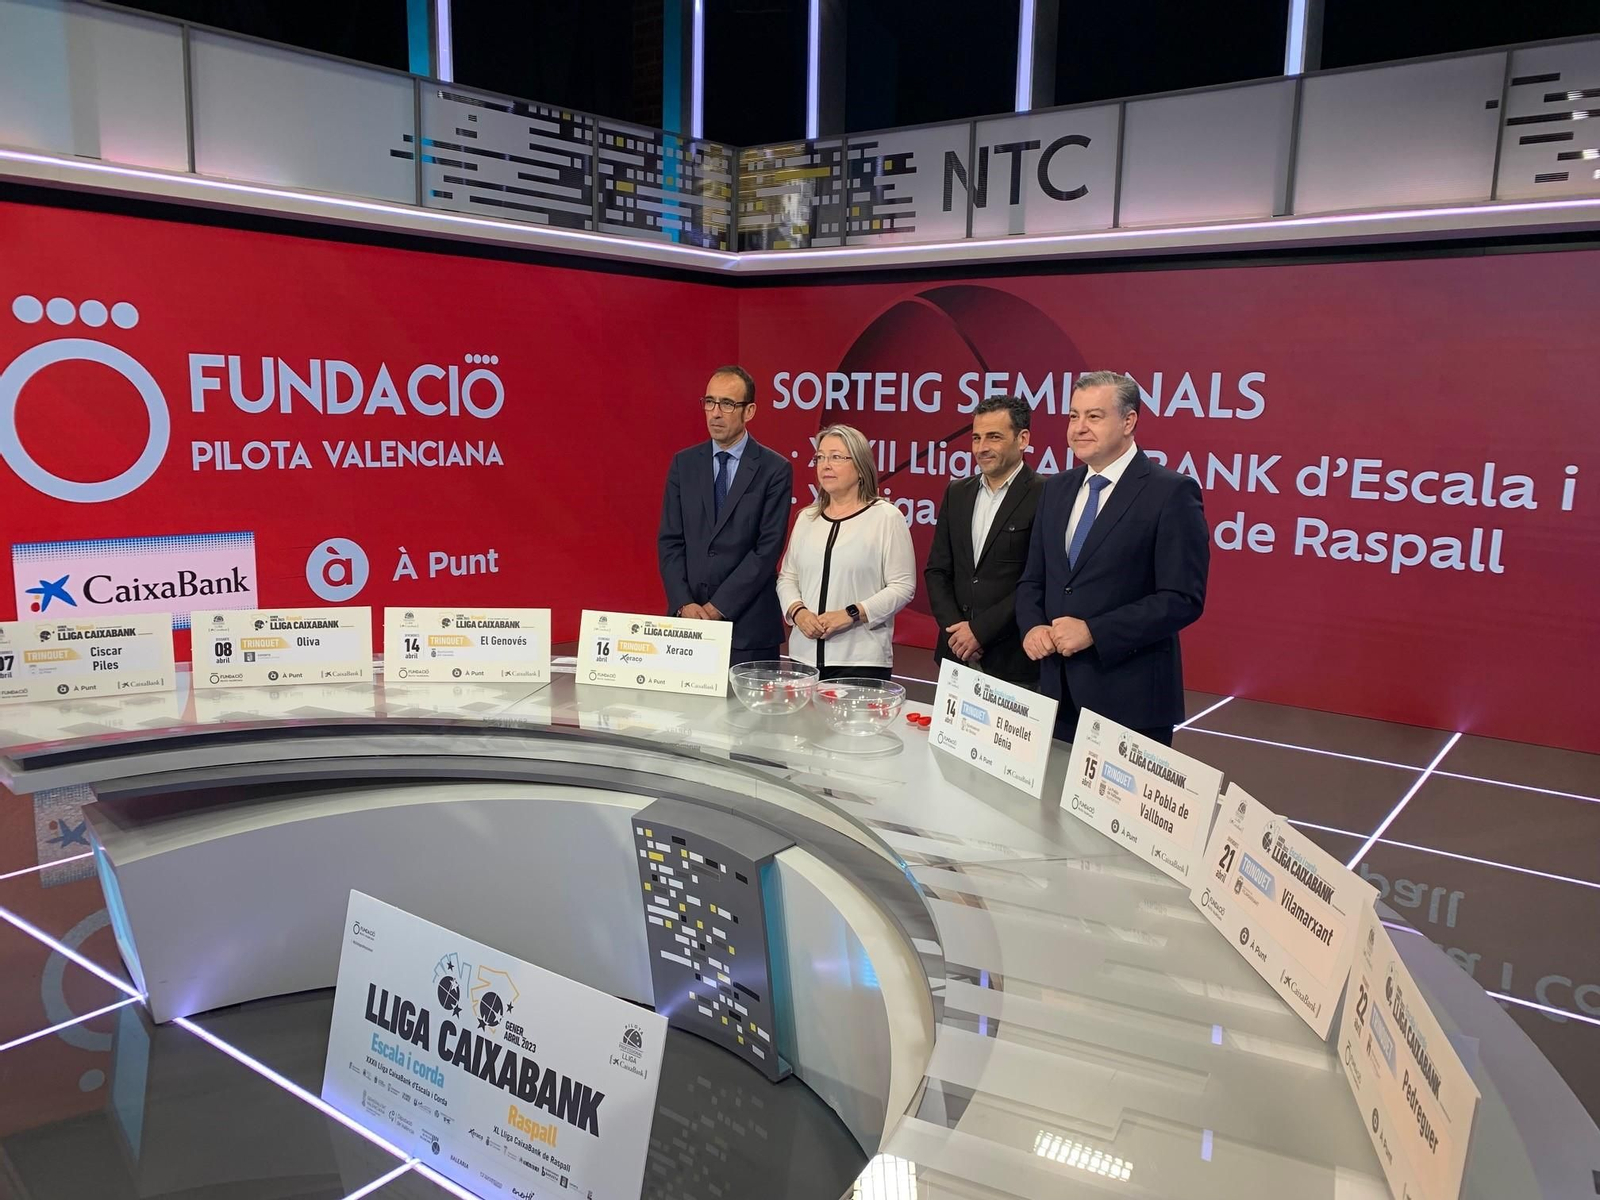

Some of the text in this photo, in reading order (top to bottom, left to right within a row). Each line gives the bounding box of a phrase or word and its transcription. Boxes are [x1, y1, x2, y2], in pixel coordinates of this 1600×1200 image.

[943, 135, 1091, 211] NTC
[773, 371, 1266, 419] SORTEIG SEMINALS
[192, 440, 504, 470] PILOTA VALENCIANA
[910, 440, 982, 479] Llig
[1561, 465, 1579, 511] i
[1214, 512, 1276, 554] de
[1294, 517, 1505, 574] Raspall
[392, 546, 499, 582] À Punt
[82, 566, 250, 605] CaixaBank
[57, 630, 84, 641] LLIGA
[84, 628, 136, 640] CAIXABANK
[270, 620, 339, 630] LLIGA CAIXABANK
[456, 620, 520, 629] LLIGA CAIXABANK
[644, 627, 703, 640] LLIGA CAIXABANK
[90, 646, 123, 657] Ciscar
[214, 642, 233, 657] 08
[243, 639, 280, 648] TRINQUET
[296, 637, 321, 647] Oliva
[404, 638, 420, 652] 14
[430, 636, 464, 645] TRINQUET
[480, 635, 527, 646] El Genovés
[596, 641, 610, 656] 16
[666, 645, 693, 656] Xeraco
[27, 650, 69, 661] TRINQUET
[93, 660, 119, 671] Piles
[620, 654, 643, 663] Xeraco
[946, 698, 956, 718] 14
[982, 690, 997, 705] LLIGA
[997, 697, 1030, 718] CAIXABANK
[996, 717, 1031, 742] El Rovellet
[994, 732, 1012, 751] Dénia
[1084, 757, 1097, 780] 15
[1104, 764, 1132, 788] TRINQUET
[1128, 751, 1187, 789] LLIGA CAIXABANK
[1081, 778, 1092, 789] abril
[1143, 783, 1189, 820] La Pobla de
[1140, 803, 1174, 834] Vallbona
[1126, 831, 1138, 843] Punt
[1161, 852, 1186, 873] CaixaBank
[1219, 844, 1236, 873] 21
[1215, 869, 1227, 883] abril
[1241, 857, 1271, 891] TRINQUET
[1271, 845, 1291, 872] LLIGA
[1290, 860, 1335, 905] CAIXABANK
[1281, 888, 1333, 946] Vilamarxant
[1255, 946, 1267, 962] Punt
[1290, 981, 1317, 1013] CaixaBank
[1356, 984, 1368, 1026] 22
[504, 1031, 537, 1053] ABRIL 2023
[1392, 998, 1407, 1039] LLIGA
[1406, 1026, 1441, 1101] CAIXABANK
[364, 983, 606, 1138] LLIGA CAIXABANK
[371, 1032, 445, 1089] Escala i corda
[622, 1053, 637, 1064] LLIGA
[377, 1061, 388, 1074] Lliga
[388, 1068, 411, 1086] CaixaBank
[433, 1094, 448, 1107] Corda
[1402, 1069, 1439, 1155] Pedreguer
[508, 1104, 559, 1148] Raspall
[493, 1125, 500, 1135] XL
[500, 1129, 513, 1142] Lliga
[514, 1137, 541, 1157] CaixaBank
[542, 1152, 550, 1161] de
[550, 1156, 571, 1173] Raspall
